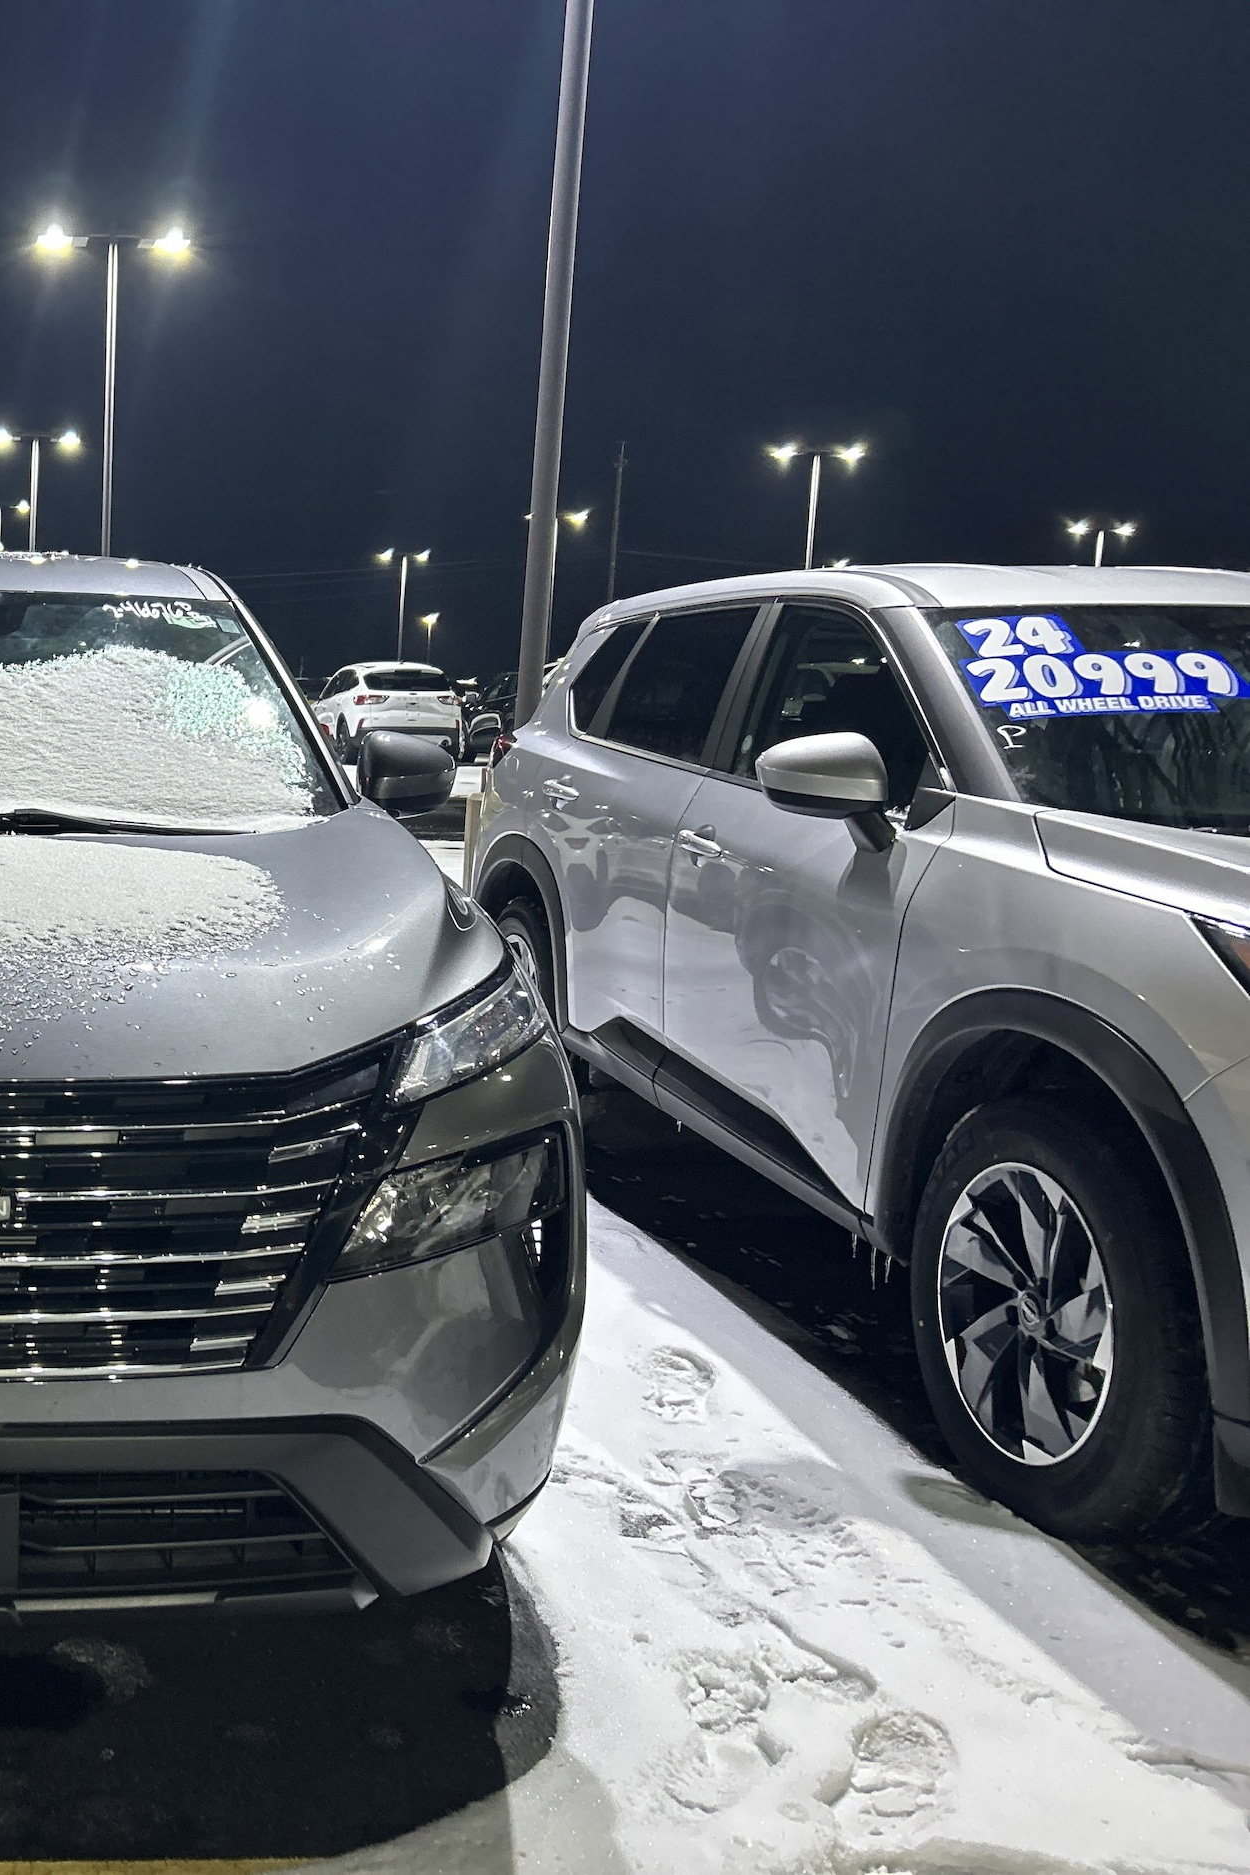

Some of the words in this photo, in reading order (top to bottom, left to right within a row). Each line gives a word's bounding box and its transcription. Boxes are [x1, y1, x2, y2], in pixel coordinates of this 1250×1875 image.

[963, 616, 1075, 657] 24
[966, 652, 1239, 702] 20999
[1009, 700, 1056, 717] ALL
[1055, 696, 1139, 713] WHEEL
[1139, 694, 1211, 710] DRIVE
